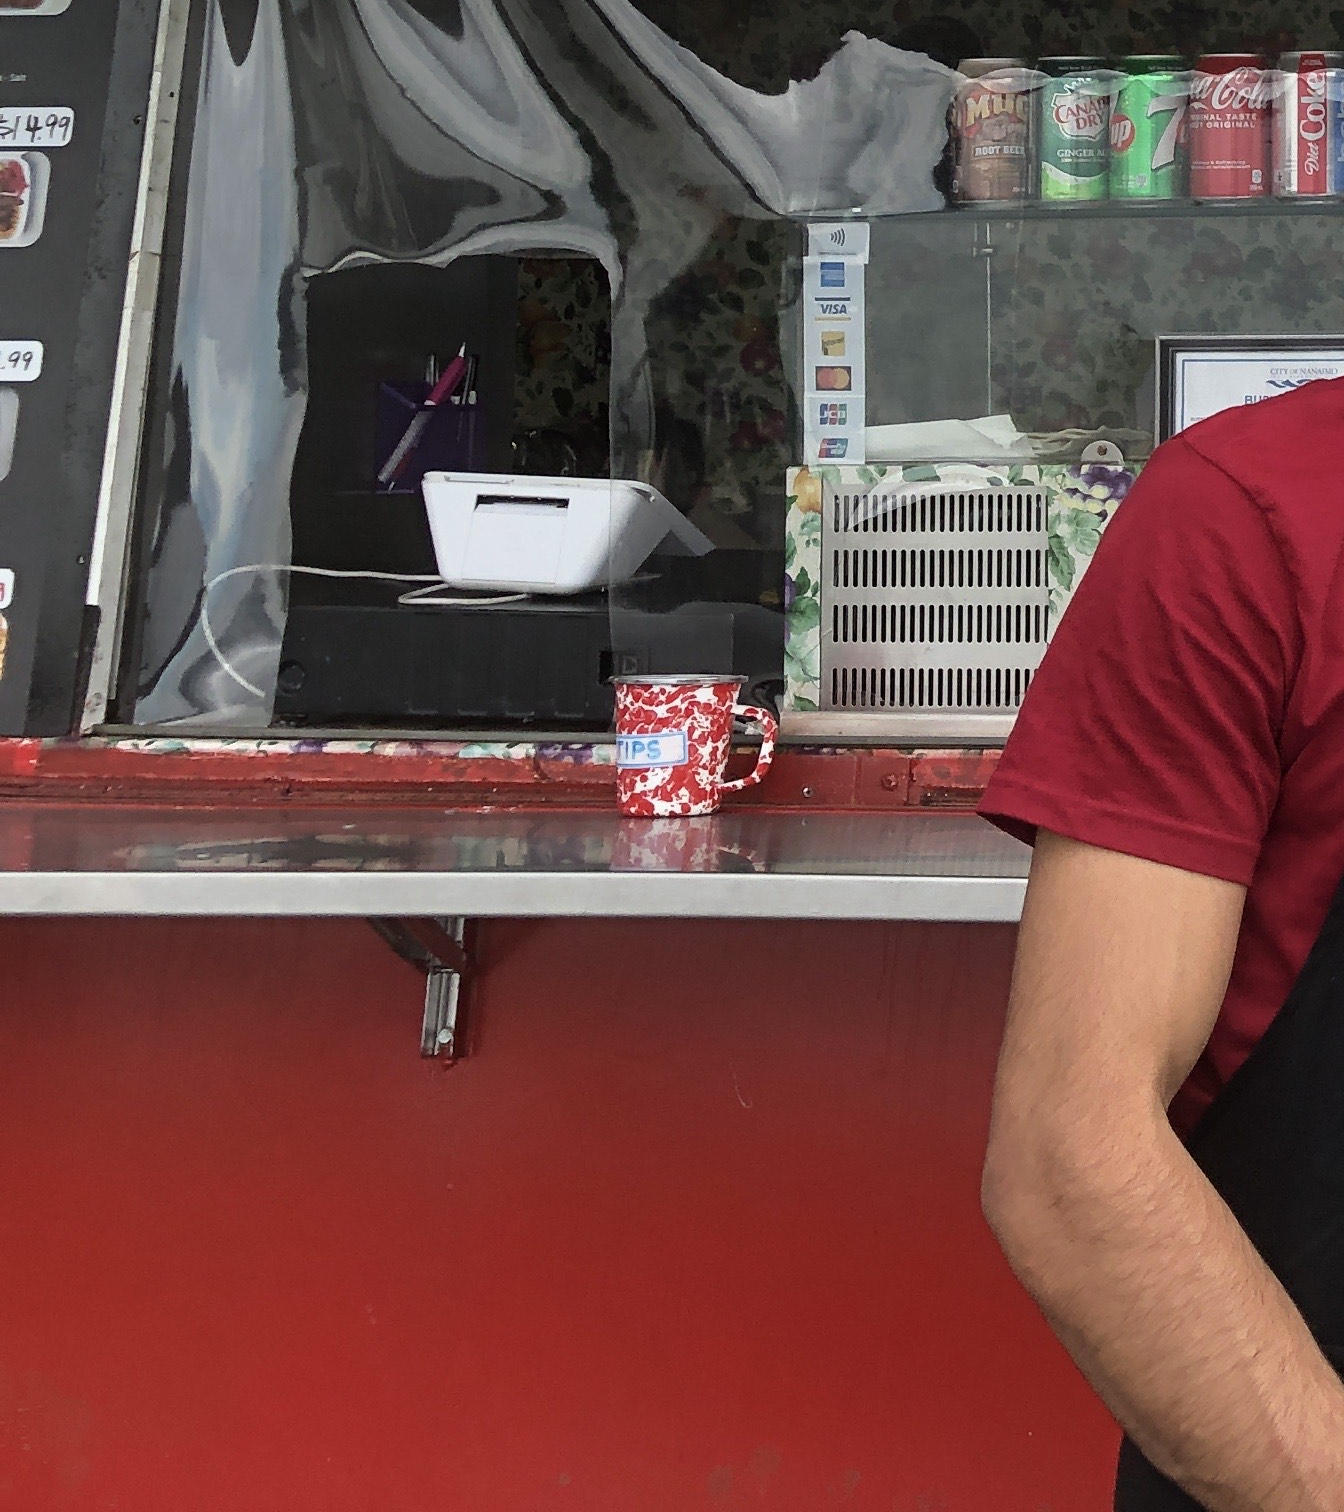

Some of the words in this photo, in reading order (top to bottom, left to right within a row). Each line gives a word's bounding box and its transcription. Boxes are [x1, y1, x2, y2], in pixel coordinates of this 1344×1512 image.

[1299, 71, 1326, 141] Coke
[1056, 147, 1095, 158] GINGER
[820, 303, 848, 315] VISA
[1269, 367, 1289, 376] CITY
[617, 739, 662, 760] TIPS
